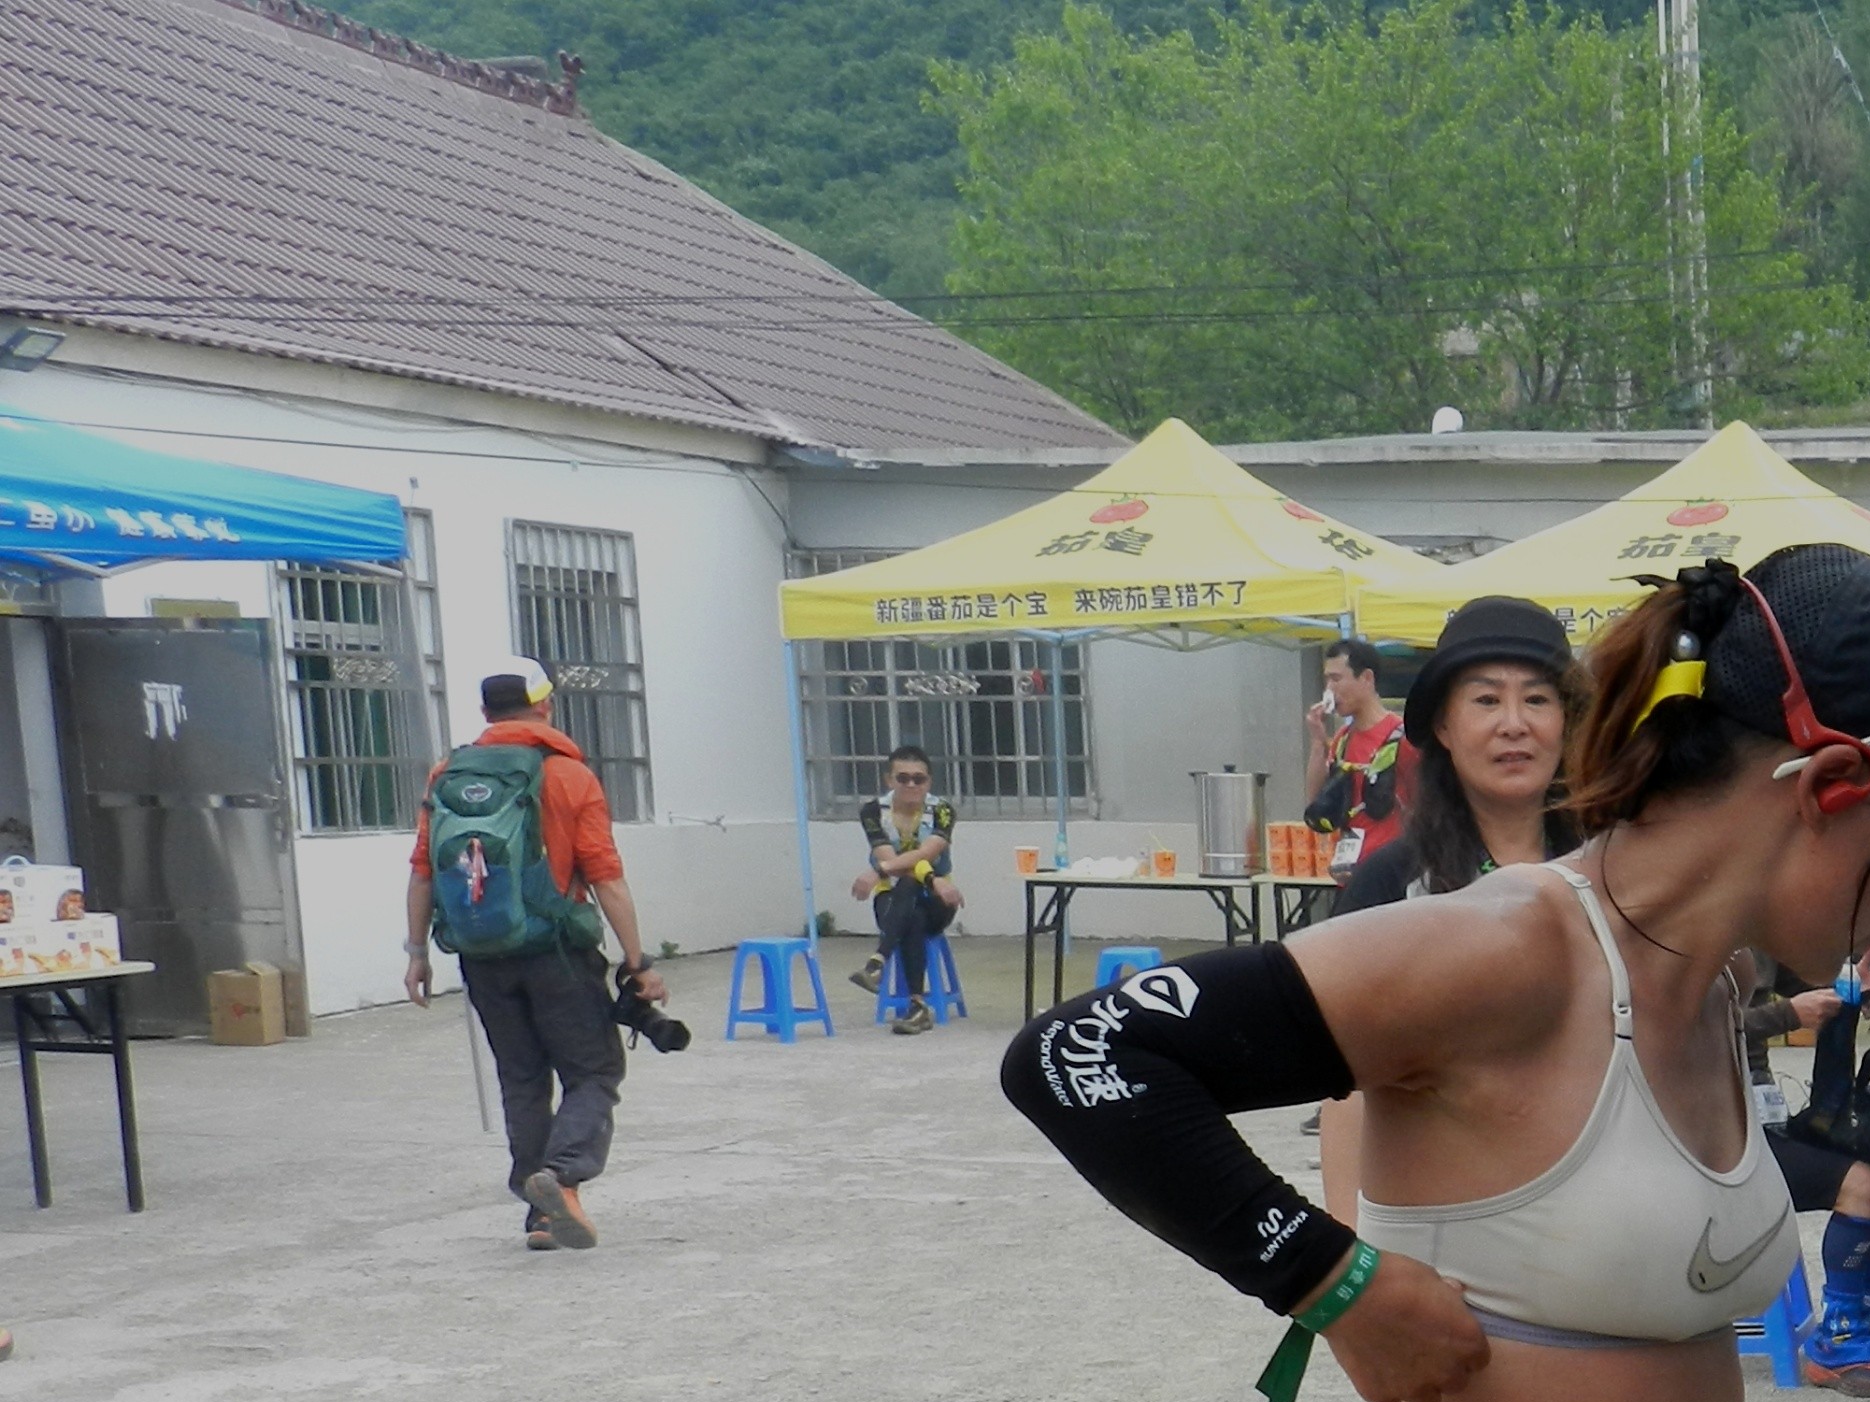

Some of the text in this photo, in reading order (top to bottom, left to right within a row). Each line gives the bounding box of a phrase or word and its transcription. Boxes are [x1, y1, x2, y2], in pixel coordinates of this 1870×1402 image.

[1035, 526, 1153, 558] 茄皇
[1617, 532, 1741, 560] 茄皇
[876, 580, 1247, 623] 新疆番茄是个宝 来碗茄皇错不了
